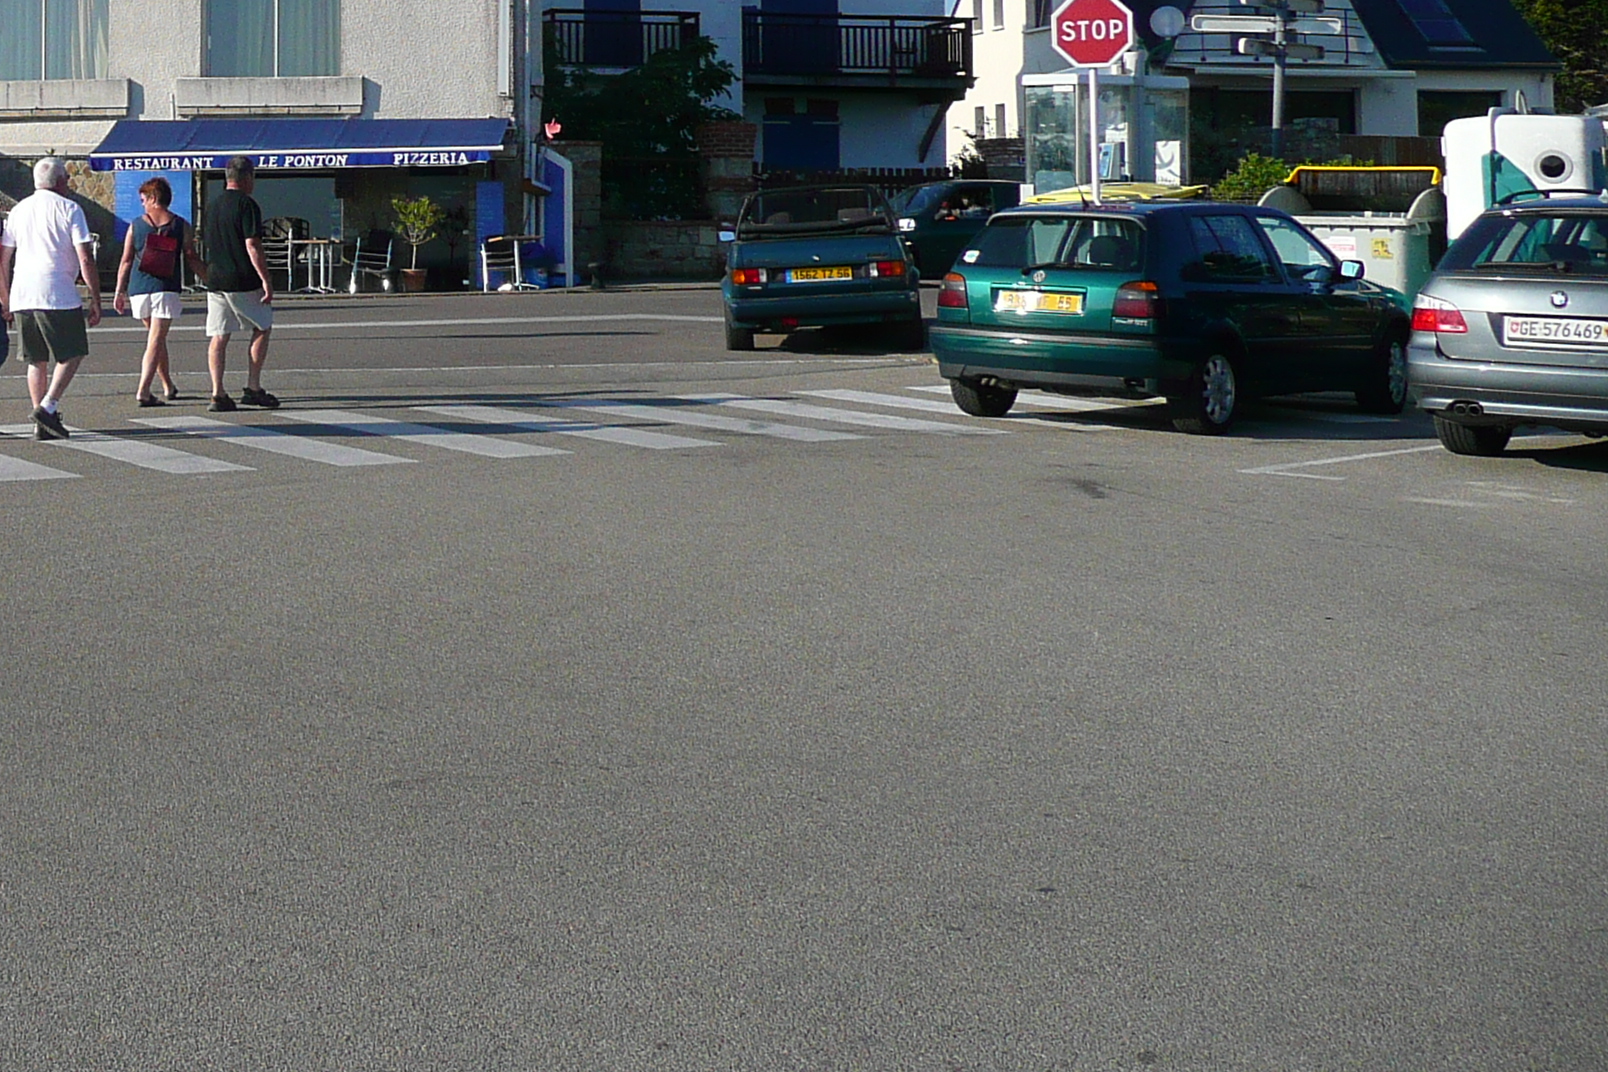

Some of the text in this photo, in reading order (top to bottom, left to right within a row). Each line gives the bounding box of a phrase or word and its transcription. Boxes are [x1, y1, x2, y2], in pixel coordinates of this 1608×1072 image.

[1061, 19, 1123, 41] STOP
[113, 152, 468, 170] RESTAURANT LE PONTON PIZZERIA
